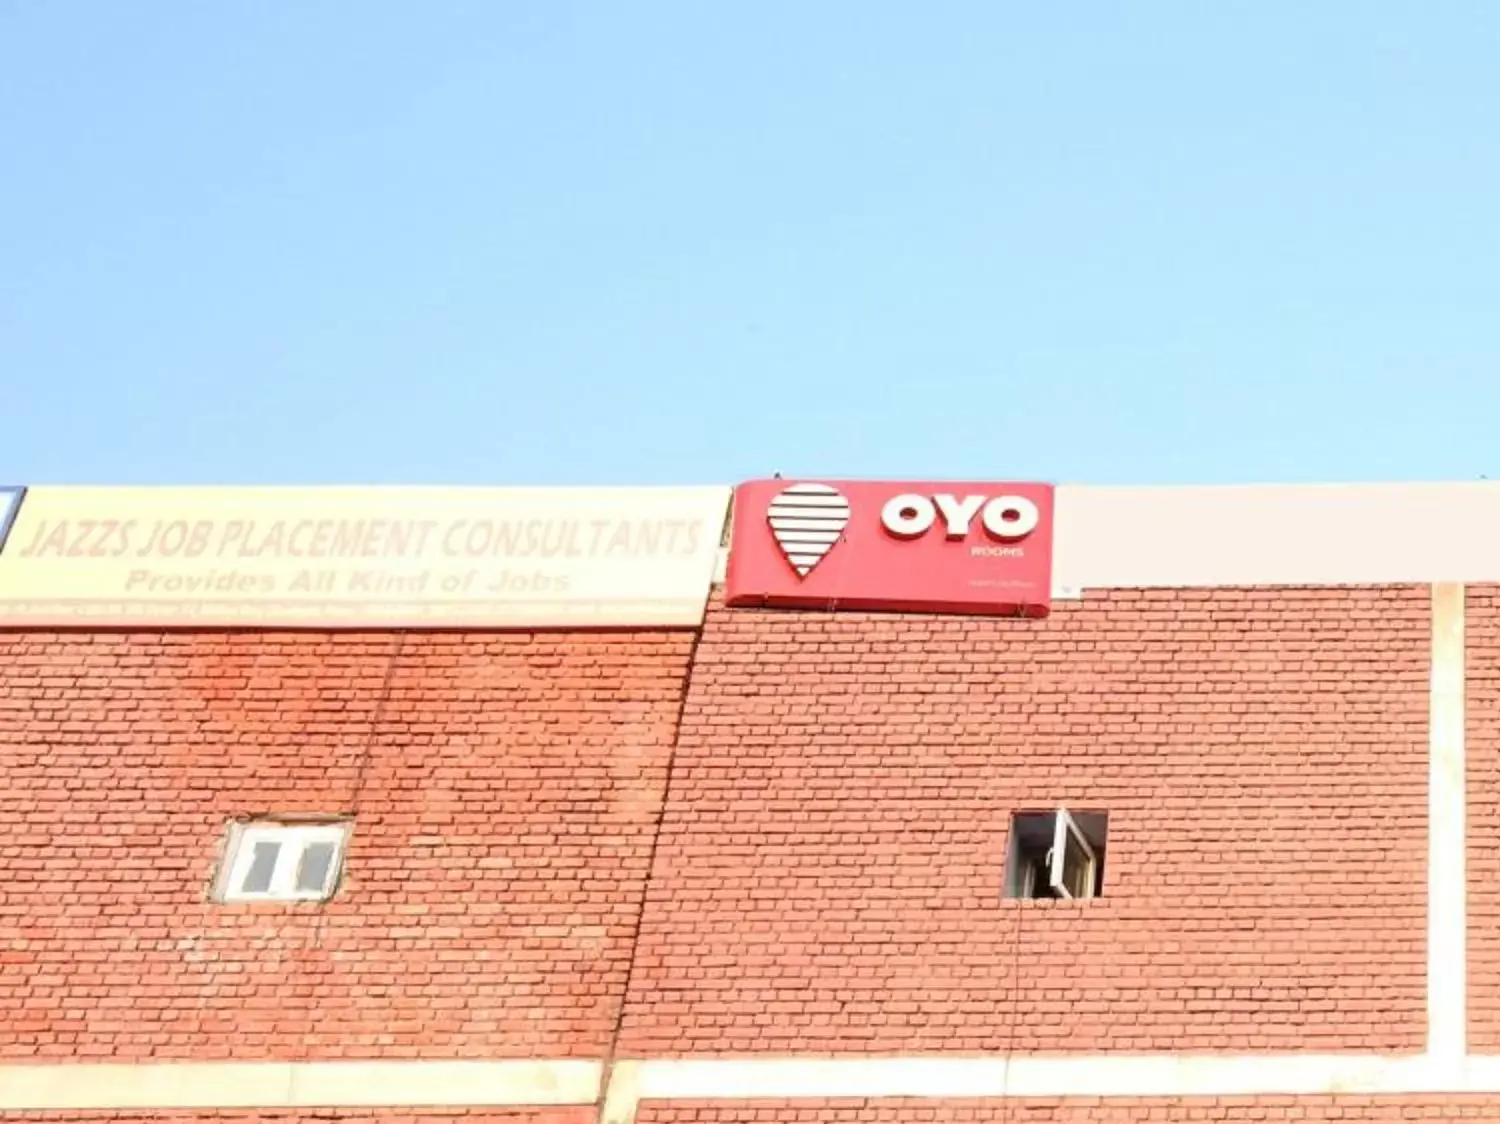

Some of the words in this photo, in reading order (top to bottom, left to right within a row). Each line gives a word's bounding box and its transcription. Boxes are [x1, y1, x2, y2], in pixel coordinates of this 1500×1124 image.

[881, 494, 1039, 543] OYO
[20, 519, 138, 558] JAZZS
[137, 519, 214, 558] JOB
[216, 519, 438, 558] PLACEMENT
[443, 519, 704, 557] CONSULTANTS
[124, 569, 276, 592] Provides
[288, 570, 337, 592] All
[346, 570, 431, 592] Kind
[439, 571, 478, 592] of
[487, 571, 572, 592] Jobs
